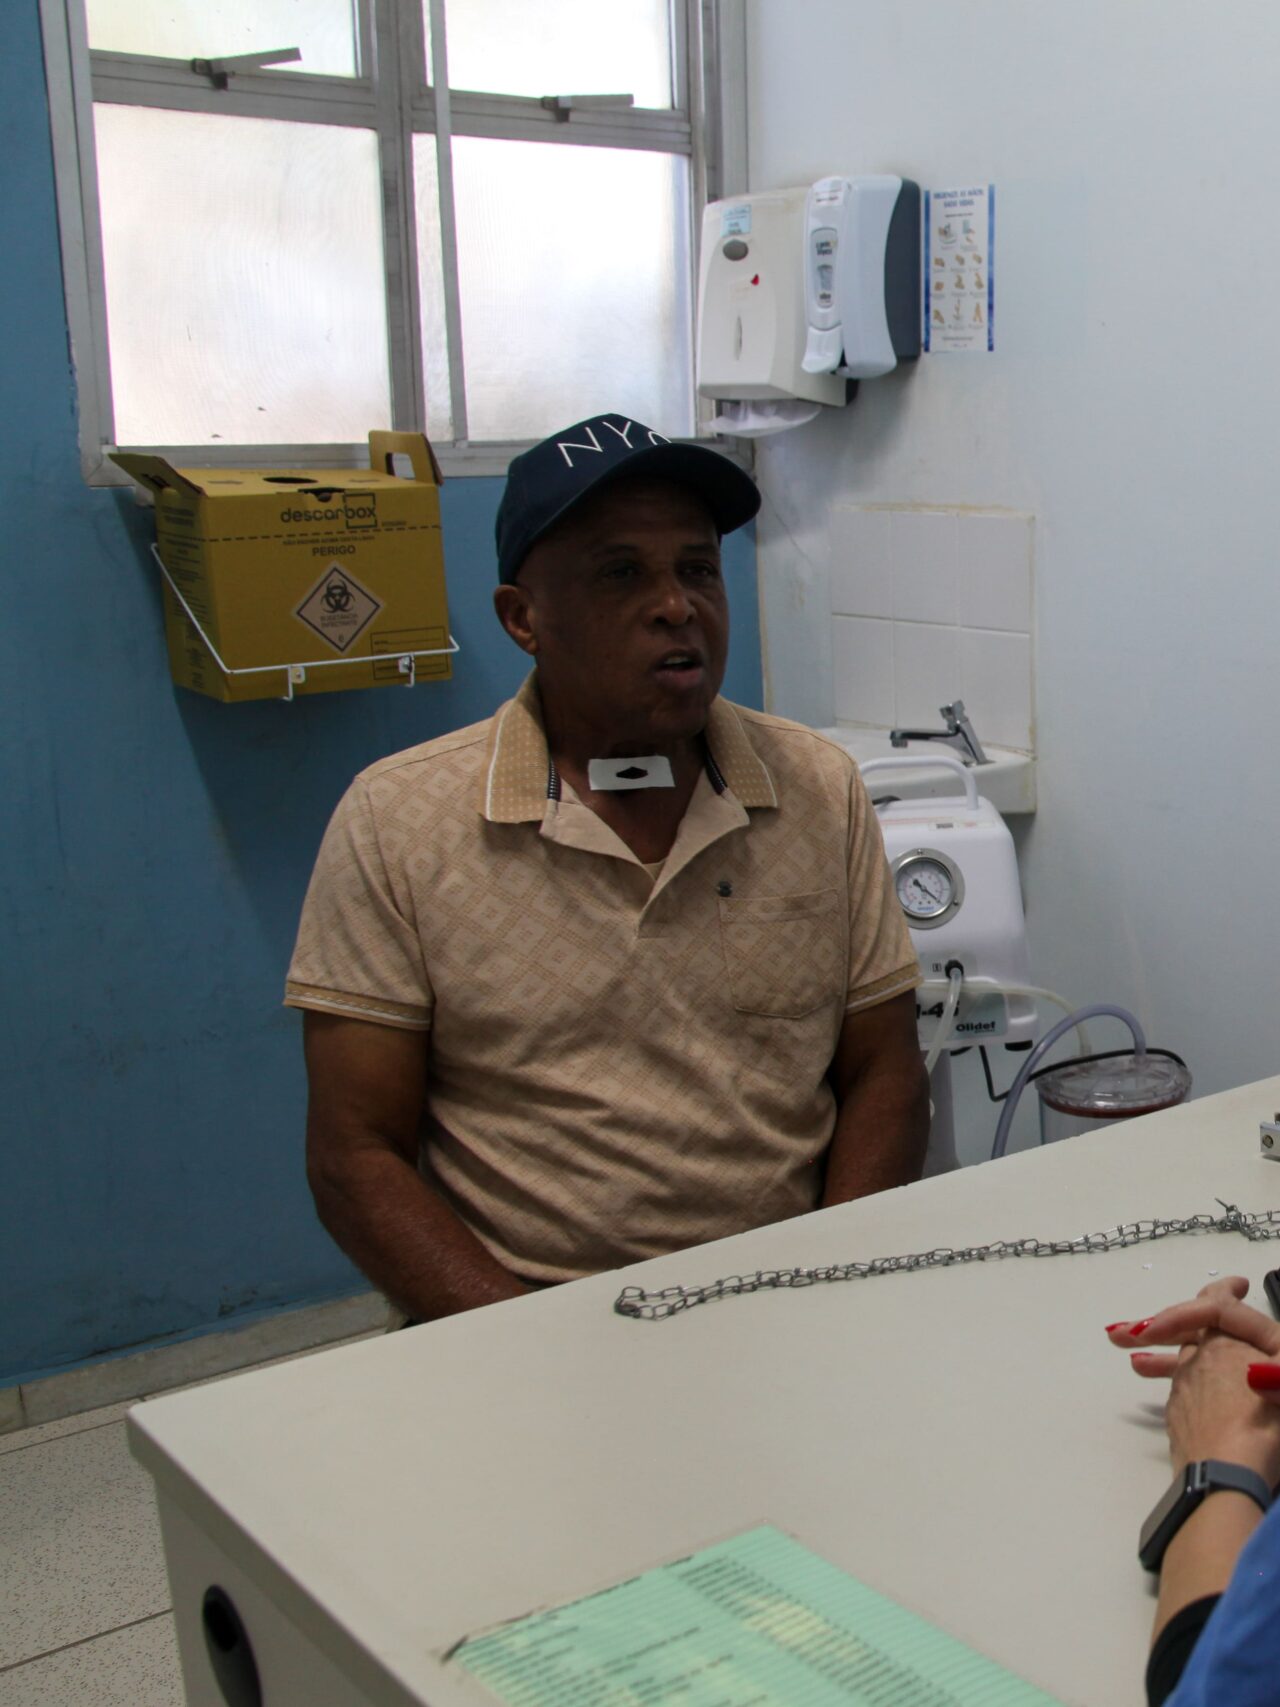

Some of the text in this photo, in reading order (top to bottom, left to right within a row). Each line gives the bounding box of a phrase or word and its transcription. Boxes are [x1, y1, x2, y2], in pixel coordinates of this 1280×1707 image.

[280, 505, 376, 523] descarbox
[312, 544, 356, 557] PERIGO
[955, 1020, 996, 1033] Olidef
